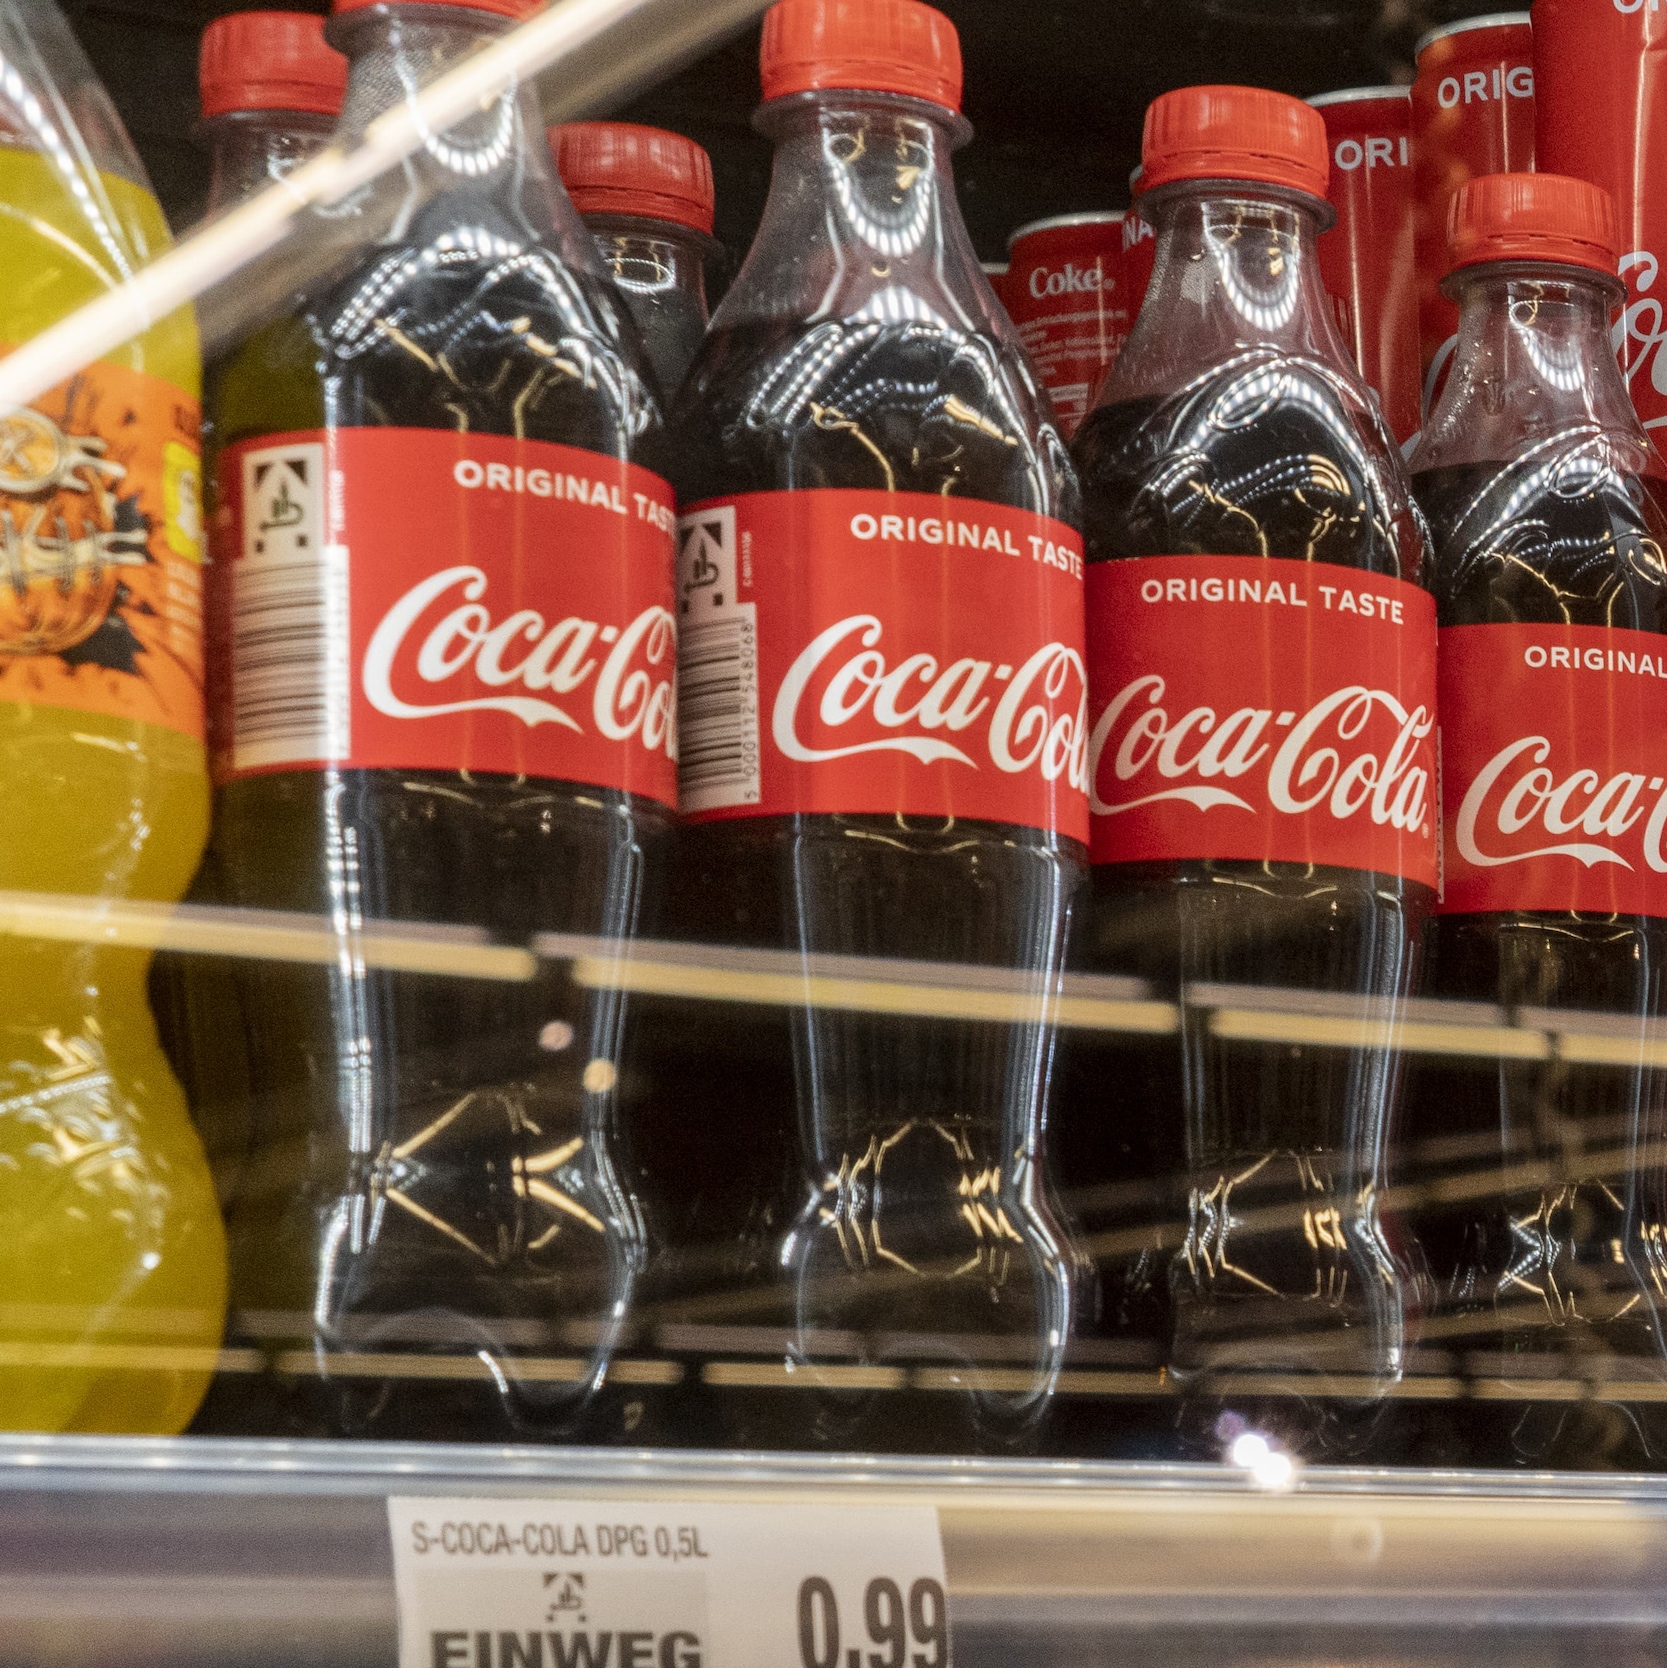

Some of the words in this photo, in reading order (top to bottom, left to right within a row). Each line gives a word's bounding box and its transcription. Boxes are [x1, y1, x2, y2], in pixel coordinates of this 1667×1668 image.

[1438, 66, 1534, 109] ORIG
[1334, 136, 1409, 171] ORI
[1029, 262, 1104, 299] Coke
[454, 459, 627, 515] ORIGINAL
[850, 513, 1021, 557] ORIGINAL
[1141, 578, 1308, 608] ORIGINAL
[1319, 586, 1405, 626] TASTE
[772, 614, 1090, 797] Coca-Col
[1090, 673, 1434, 833] Coca-Cola
[412, 1521, 589, 1556] S-COCA-COLA
[597, 1523, 649, 1557] DPG
[656, 1524, 708, 1561] 0,5L
